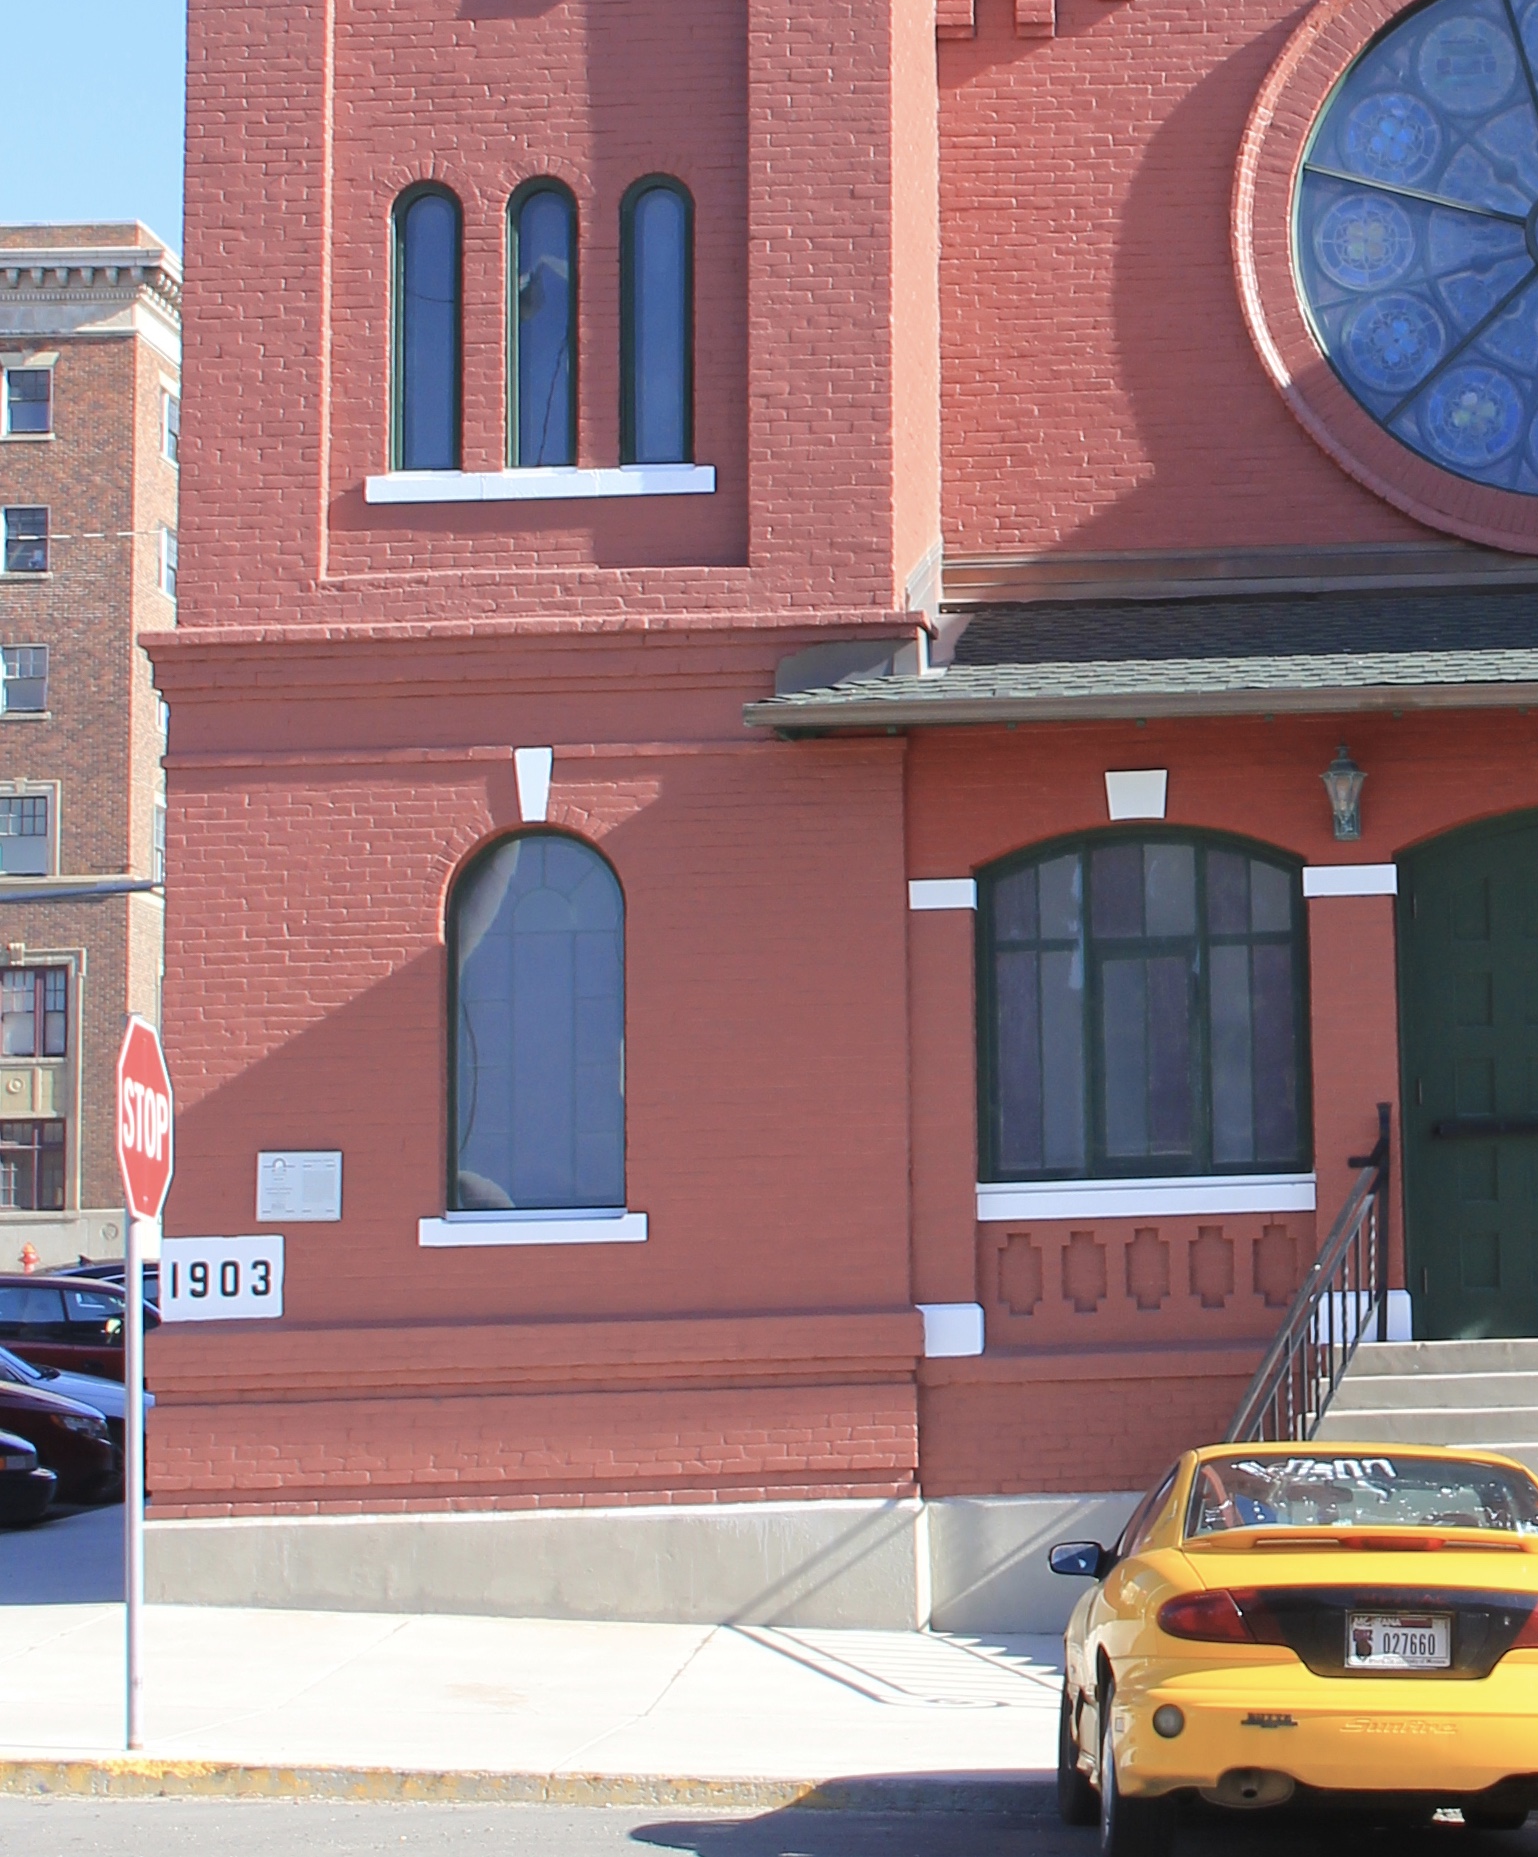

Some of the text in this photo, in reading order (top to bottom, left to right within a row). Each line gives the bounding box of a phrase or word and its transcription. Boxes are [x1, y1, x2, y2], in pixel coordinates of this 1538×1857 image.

[123, 1076, 168, 1161] STOP
[171, 1260, 271, 1299] 1903
[1383, 1633, 1435, 1655] 027660
